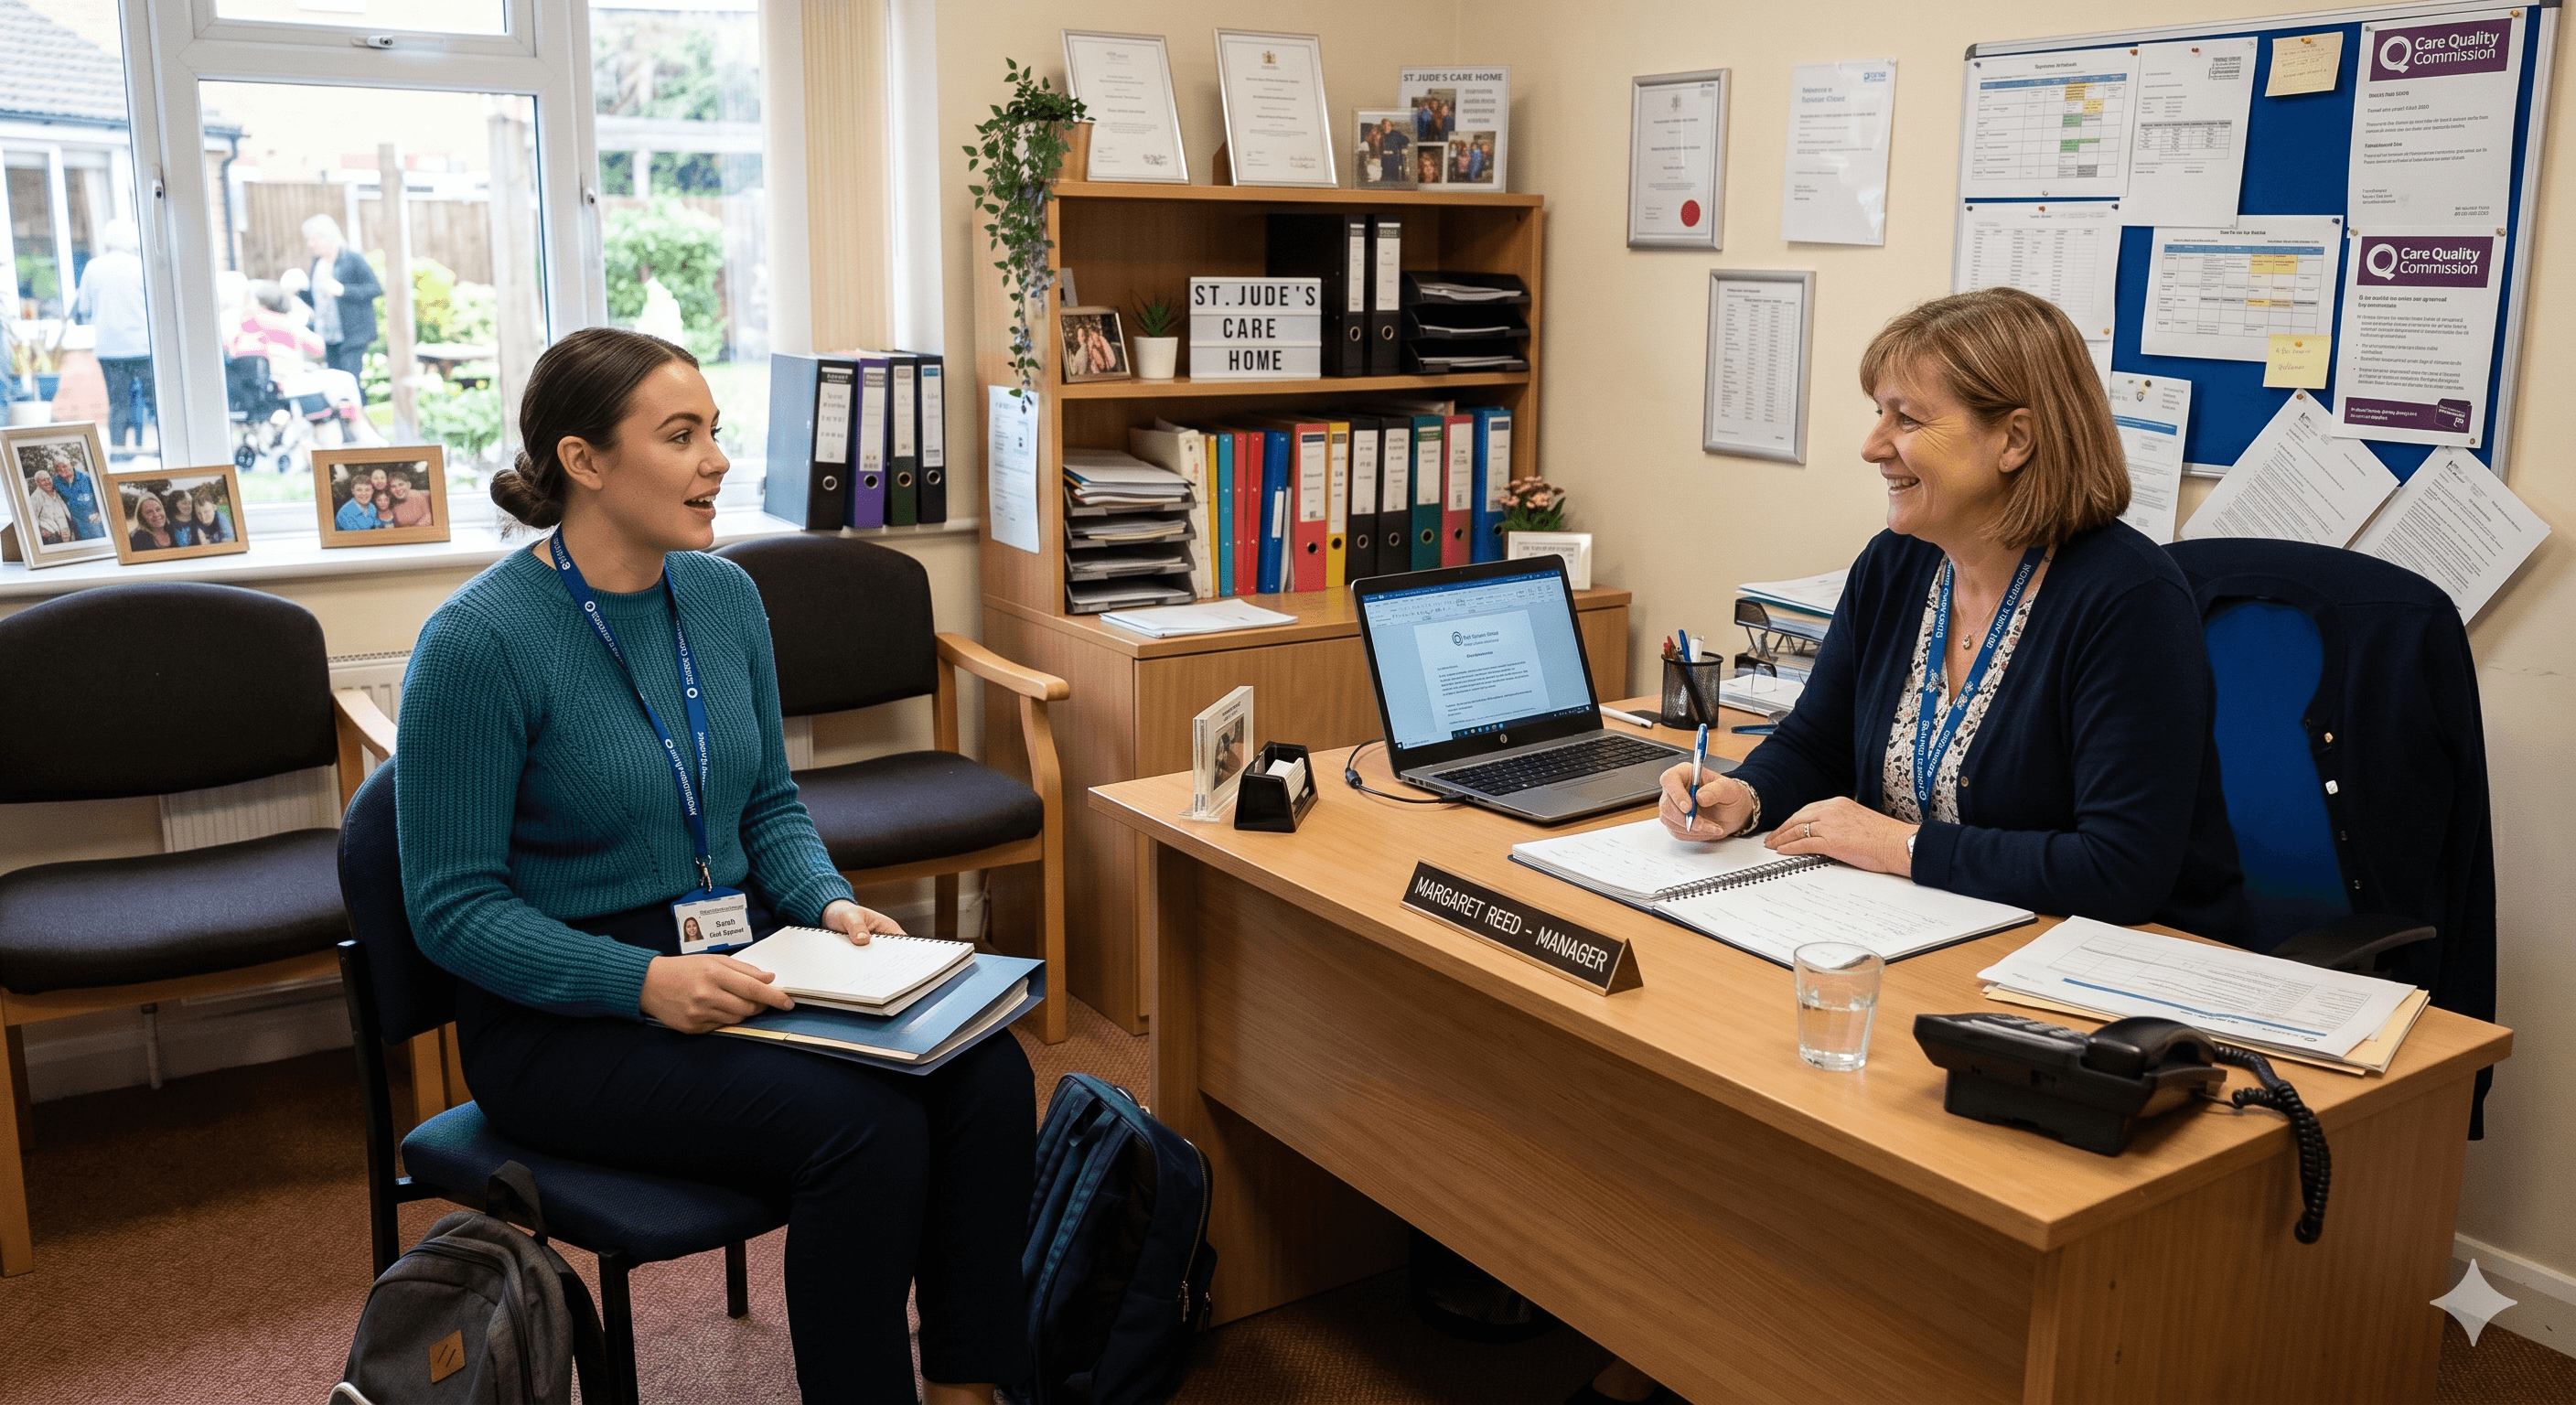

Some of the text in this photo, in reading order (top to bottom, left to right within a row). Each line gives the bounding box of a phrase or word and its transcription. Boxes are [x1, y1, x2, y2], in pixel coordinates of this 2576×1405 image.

[2415, 30, 2500, 50] Care Quality
[2414, 47, 2496, 65] Commission
[1450, 73, 1474, 81] CARE
[1476, 73, 1503, 81] HOME
[2400, 247, 2481, 263] Care Quality
[2399, 261, 2478, 274] Commission
[1195, 284, 1315, 306] ST. JUDE'S
[1223, 317, 1276, 338] CARE
[1229, 349, 1282, 370] HOME
[1414, 875, 1486, 919] MARGARET
[1485, 906, 1522, 935] REED
[1535, 926, 1608, 972] MANAGER
